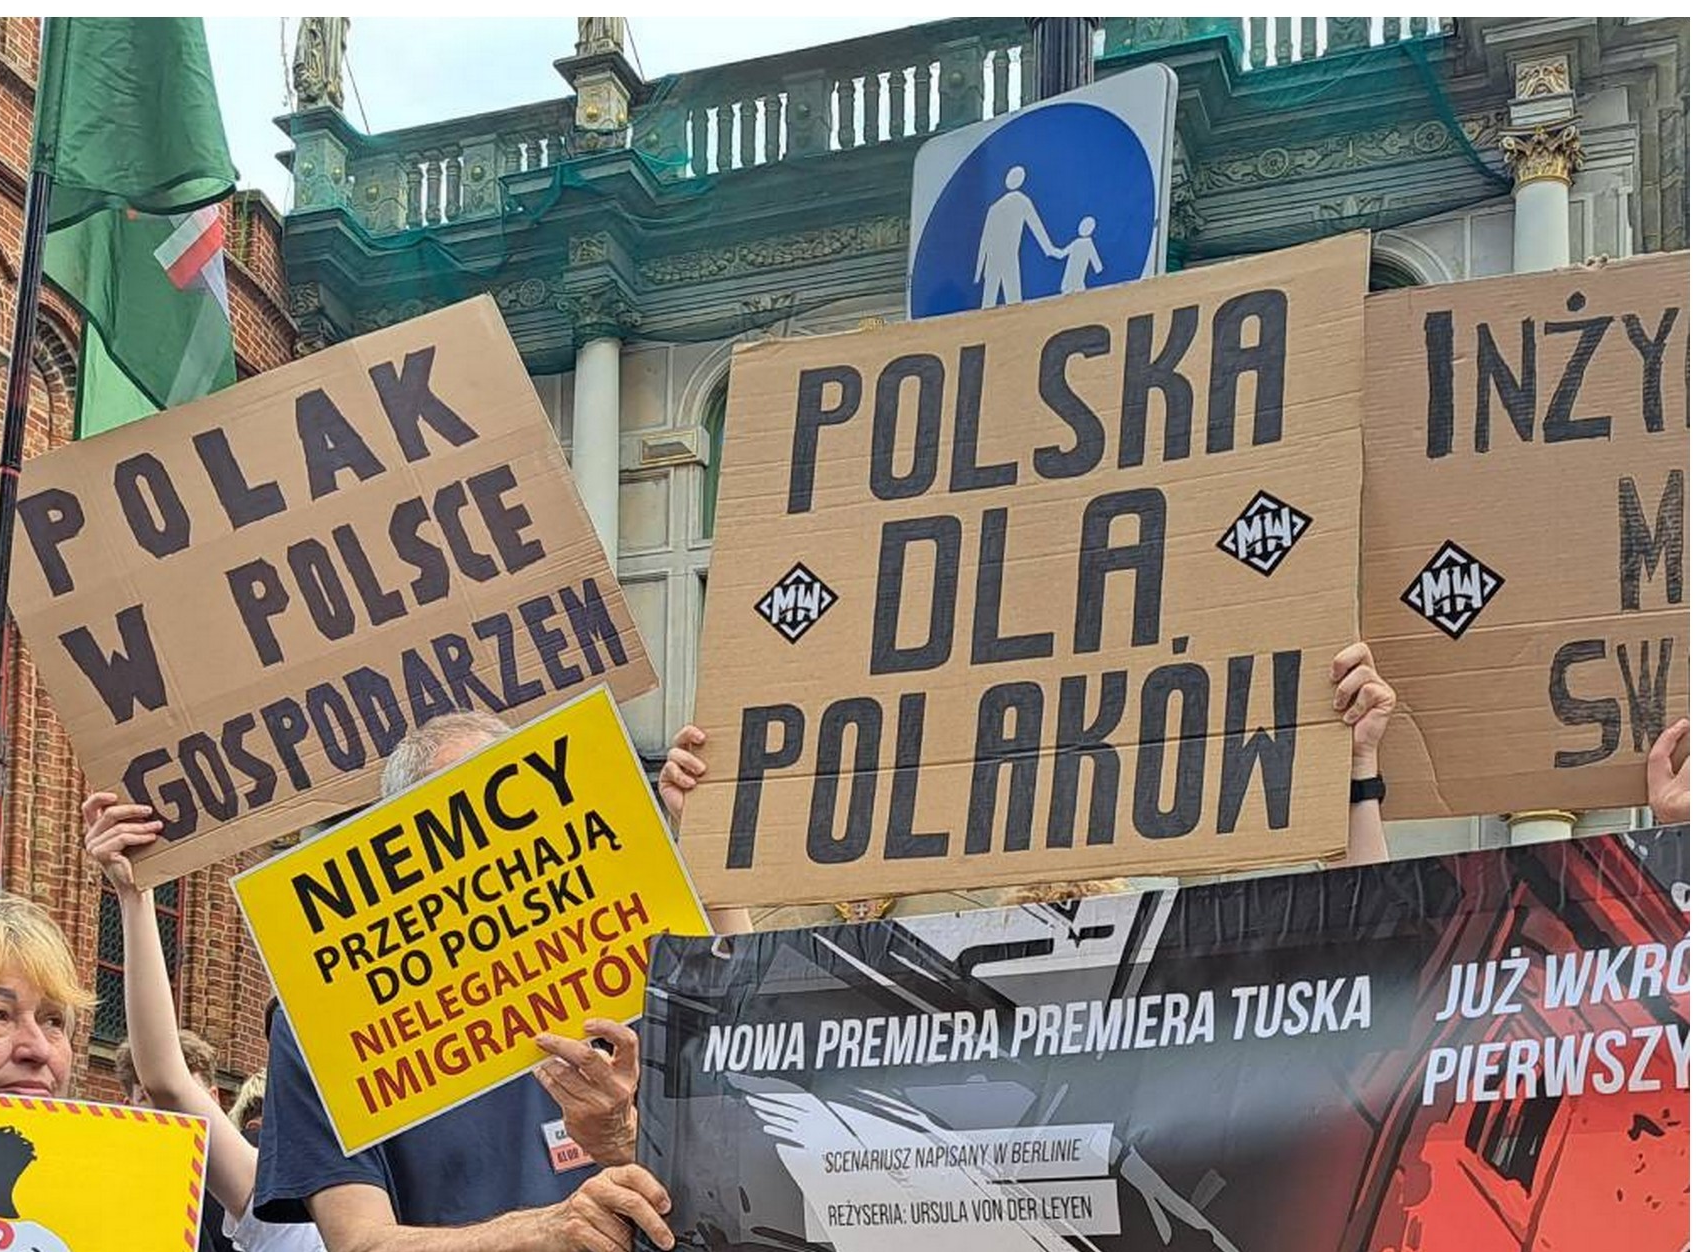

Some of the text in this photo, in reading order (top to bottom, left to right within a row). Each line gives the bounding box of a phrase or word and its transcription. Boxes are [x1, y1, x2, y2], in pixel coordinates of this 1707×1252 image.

[17, 345, 480, 597] POLAK
[787, 288, 1289, 515] POLSKA
[59, 464, 545, 724] W POLSCE
[869, 488, 1167, 676] DLA
[122, 578, 628, 842] GOSPODARZEM
[725, 635, 1302, 870] POLAKÓW
[291, 735, 575, 933] NIEMCY
[312, 809, 621, 985] PRZEPYCHAJĄ
[349, 892, 649, 1062] NIELEGALNYCH
[365, 865, 595, 1006] DO POLSKI
[702, 974, 1372, 1073] NOWA PREMIERA PREMIERA TUSKA
[1436, 947, 1530, 1021] JUŻ
[824, 1138, 1081, 1174] SCENARIUSZ NAPISANY W BERLINIE
[828, 1194, 1093, 1227] REŻYSERIA: URSULA VON DER LEYEN
